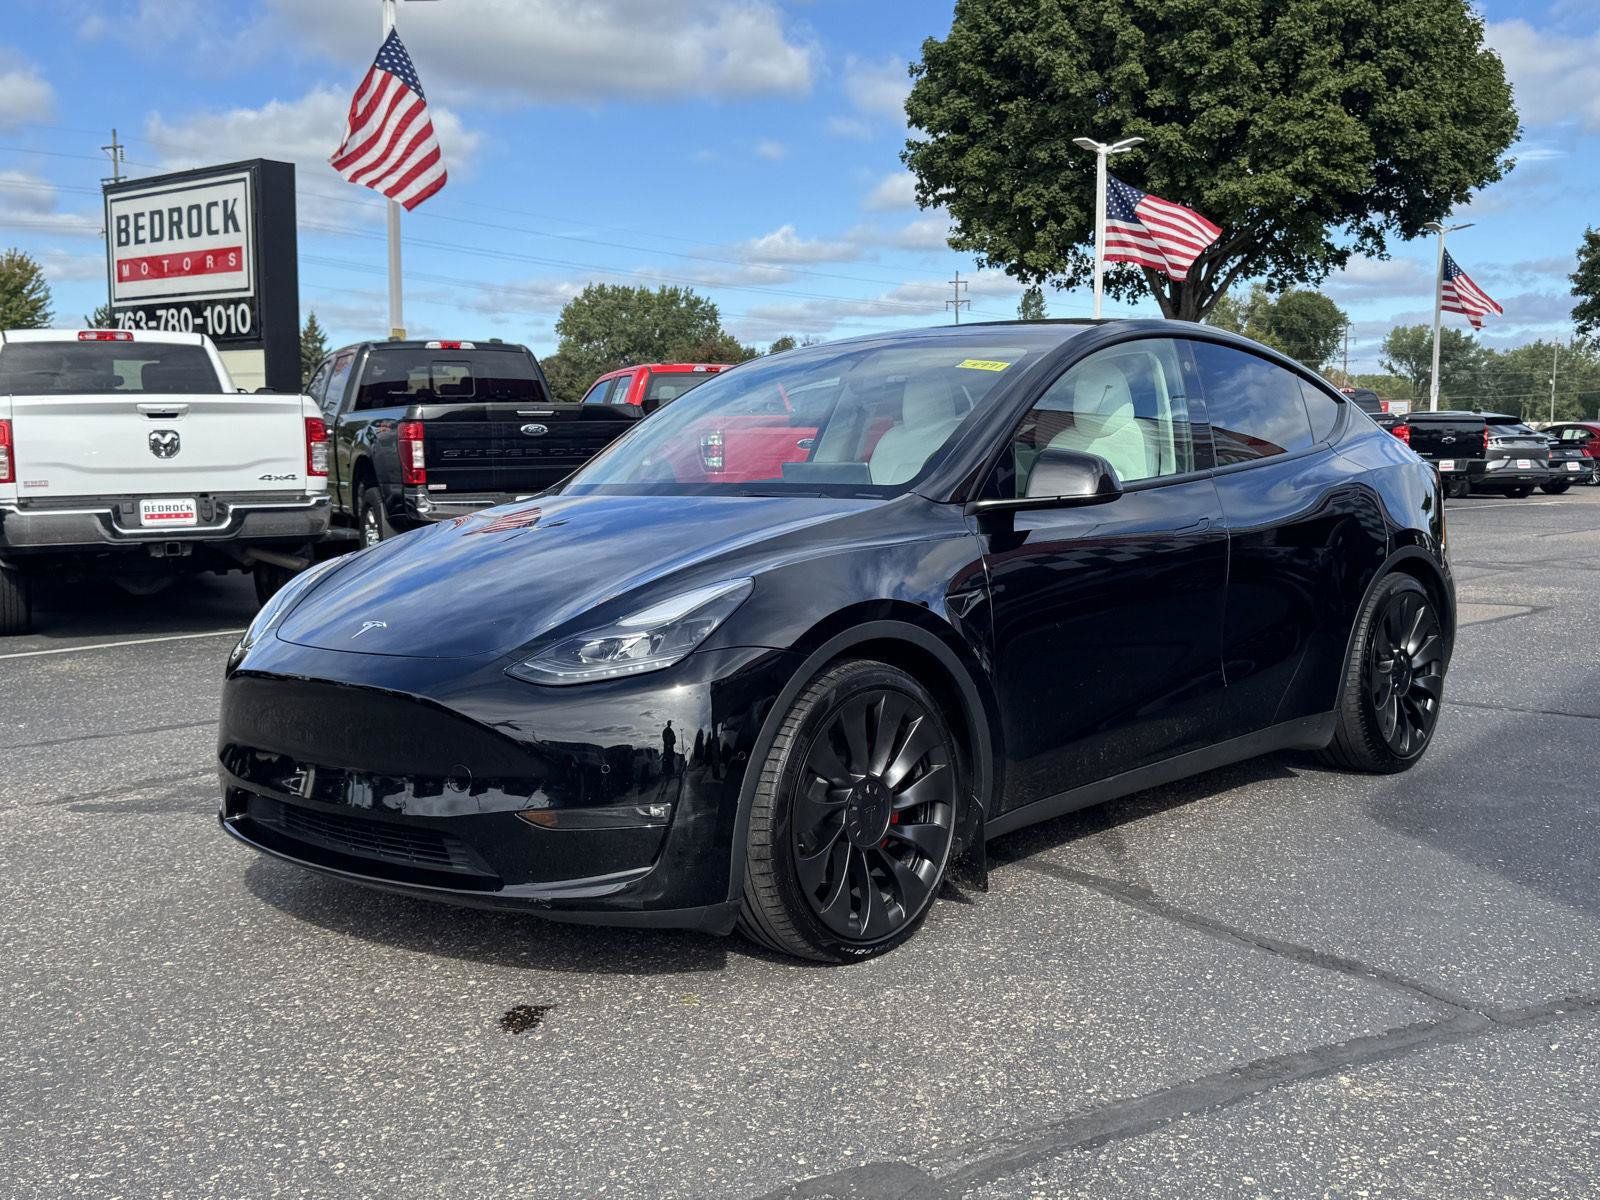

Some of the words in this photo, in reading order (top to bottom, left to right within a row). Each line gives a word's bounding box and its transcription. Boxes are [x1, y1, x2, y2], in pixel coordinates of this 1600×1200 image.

[116, 198, 241, 247] BEDROCK
[122, 252, 237, 277] MOTORS
[115, 303, 251, 335] 763-780-1010
[144, 504, 193, 512] BEDROCK
